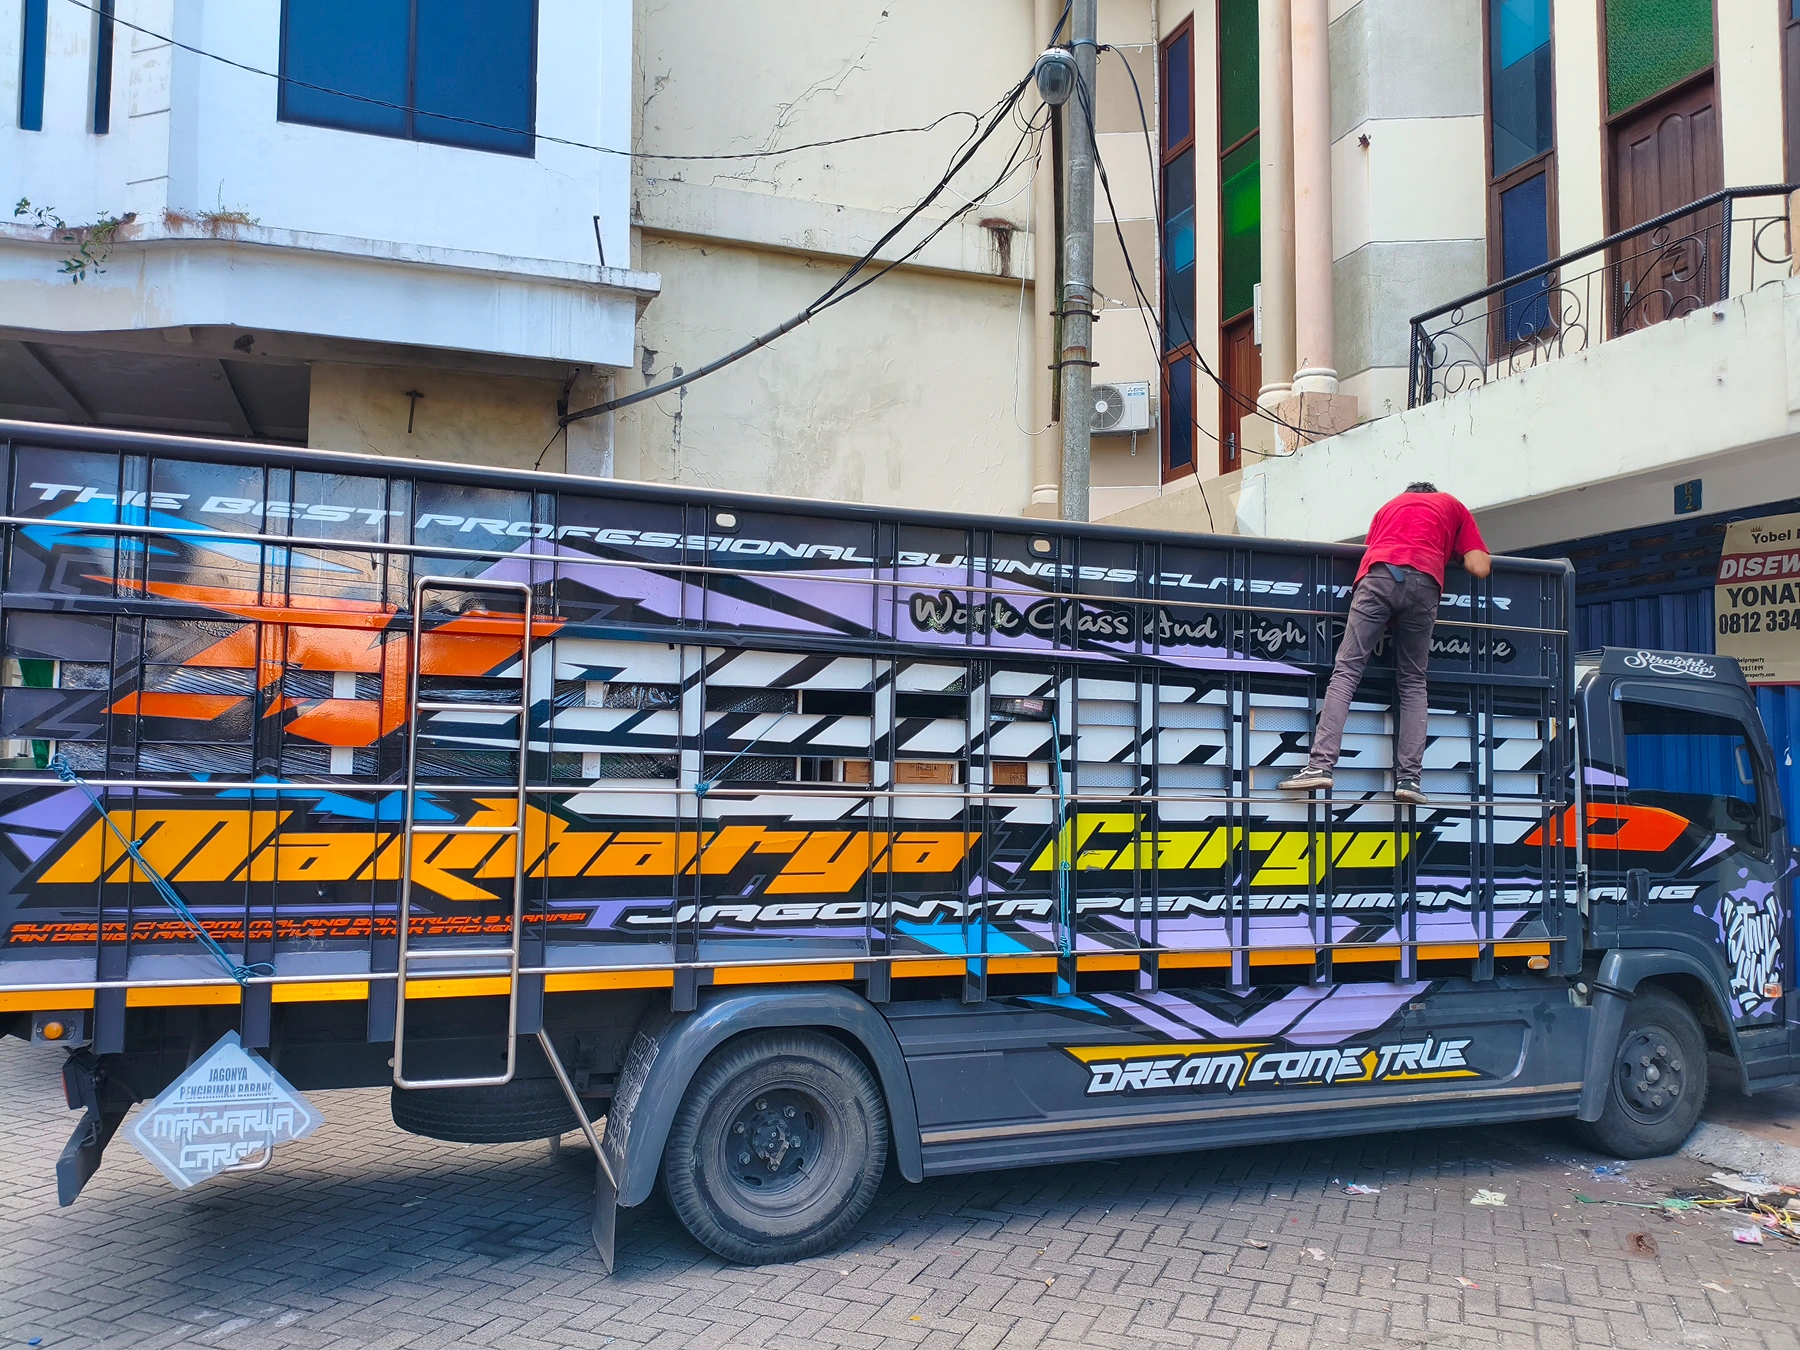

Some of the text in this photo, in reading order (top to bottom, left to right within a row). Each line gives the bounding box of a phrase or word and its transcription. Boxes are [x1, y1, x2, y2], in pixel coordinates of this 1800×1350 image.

[1685, 496, 1693, 509] 2
[29, 482, 191, 510] THE
[200, 496, 404, 525] BEST
[414, 512, 875, 563] PROFESSIONAL
[890, 551, 1138, 583] BUSINESS
[1149, 572, 1303, 596] CLASS
[1751, 529, 1791, 544] Yobel
[1726, 582, 1800, 608] YONA
[1028, 600, 1129, 635] Class
[1144, 607, 1218, 639] And
[1718, 611, 1761, 634] 0812
[36, 798, 1420, 901] Makharya Cargo
[627, 900, 1052, 924] JAGONYA
[1074, 889, 1483, 914] PENGIRIMAN
[10, 933, 49, 943] AN
[51, 931, 149, 942] DESIGN
[329, 926, 424, 936] LETTR
[11, 922, 127, 932] SUMBER
[249, 919, 353, 929] MALANG
[408, 916, 479, 925] TRUCK
[208, 1067, 248, 1083] JAGONYA
[1087, 1035, 1472, 1093] DREAM COME TRUE
